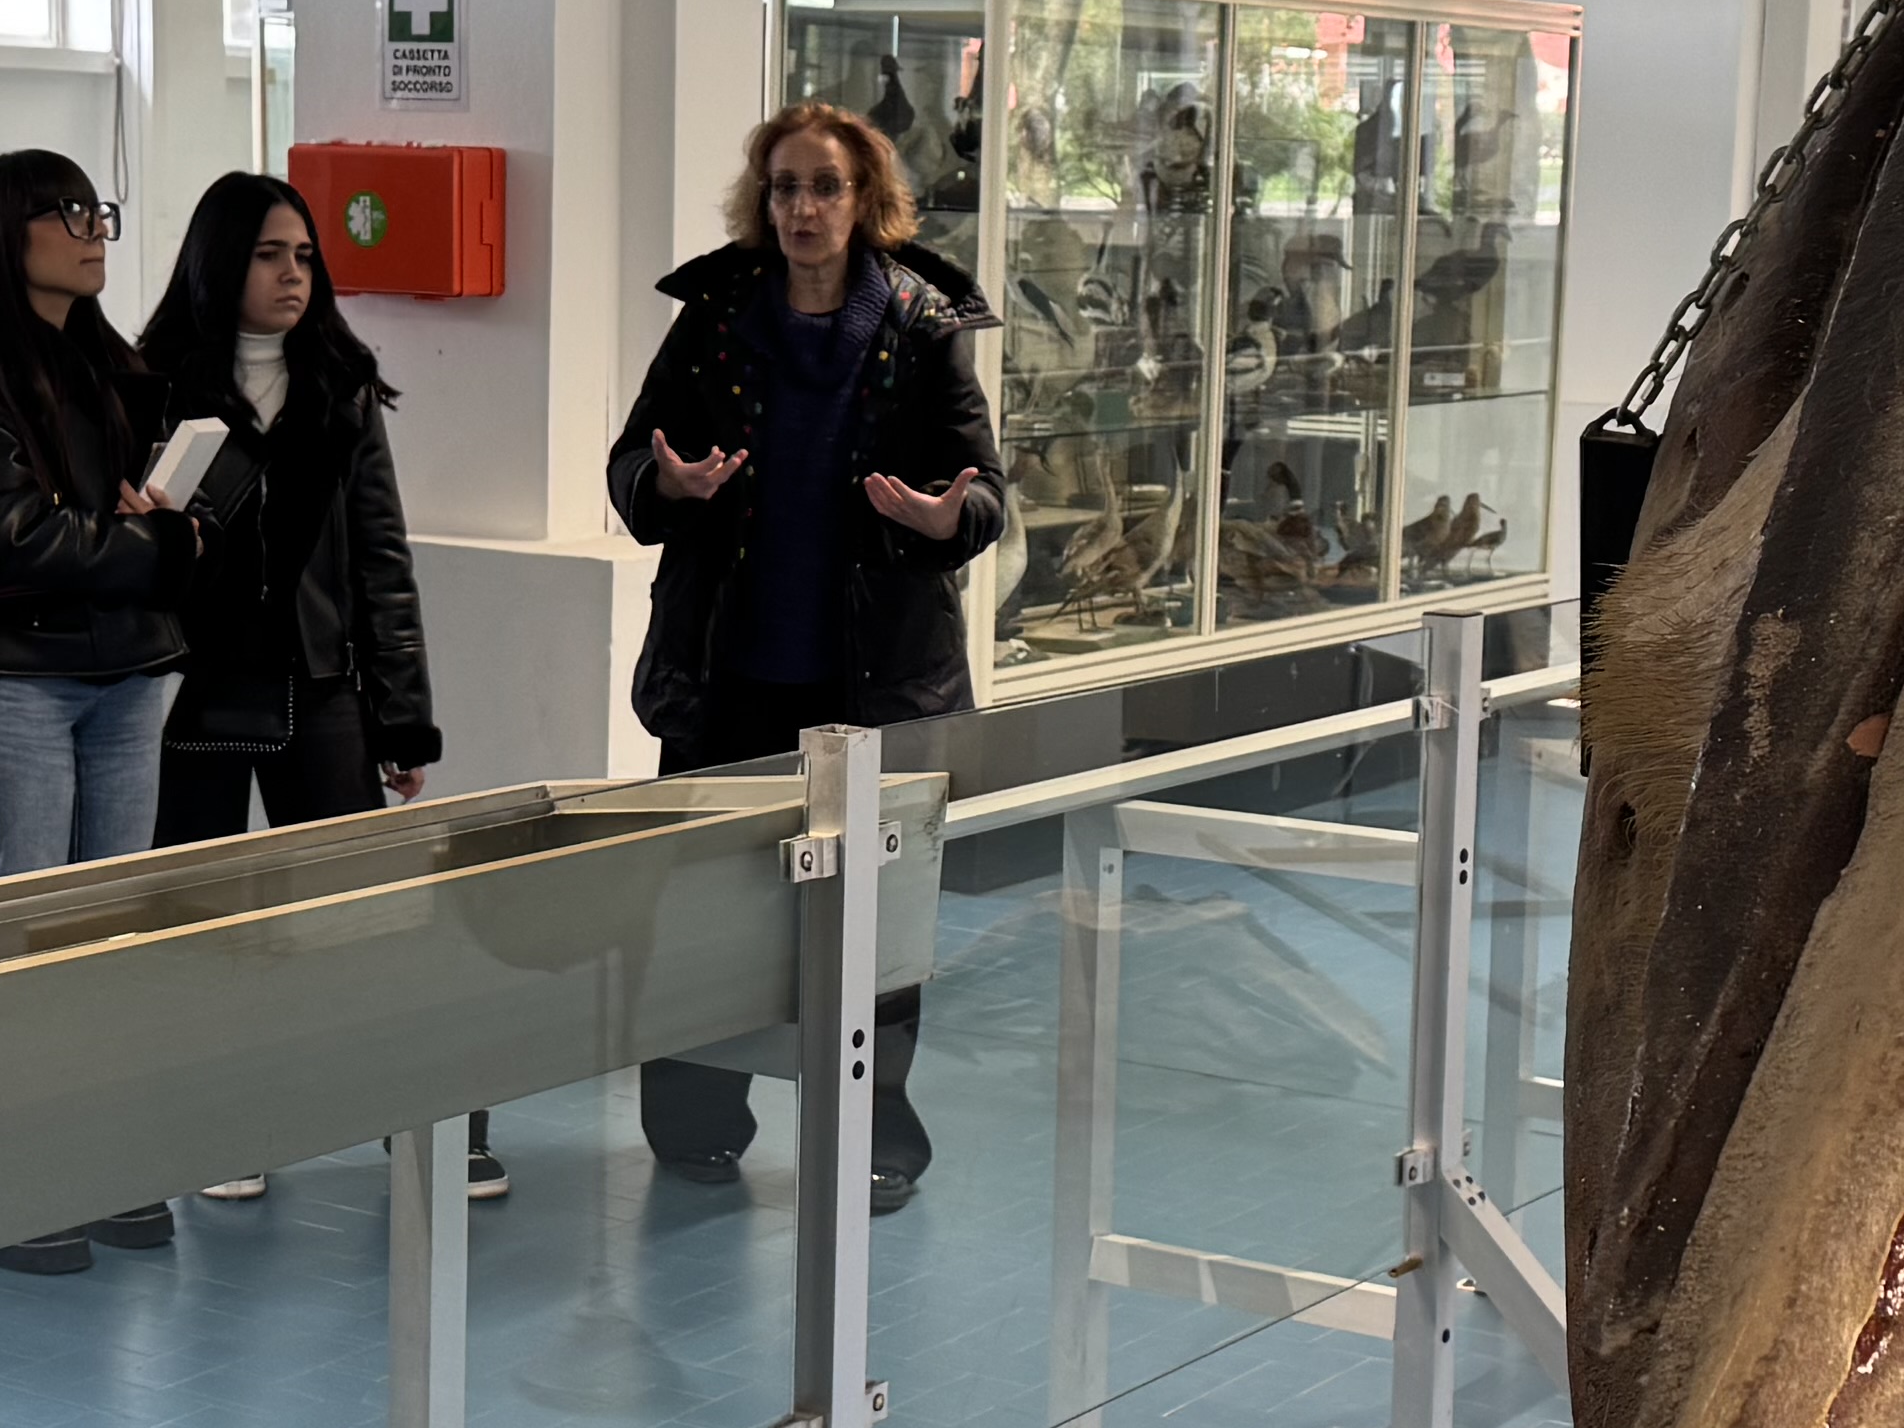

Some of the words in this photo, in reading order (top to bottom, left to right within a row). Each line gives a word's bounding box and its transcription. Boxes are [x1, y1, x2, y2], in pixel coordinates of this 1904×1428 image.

[392, 48, 450, 61] CASSETTA
[392, 64, 403, 76] DI
[405, 64, 452, 77] PRONTO
[391, 80, 454, 93] SOCCORSO
